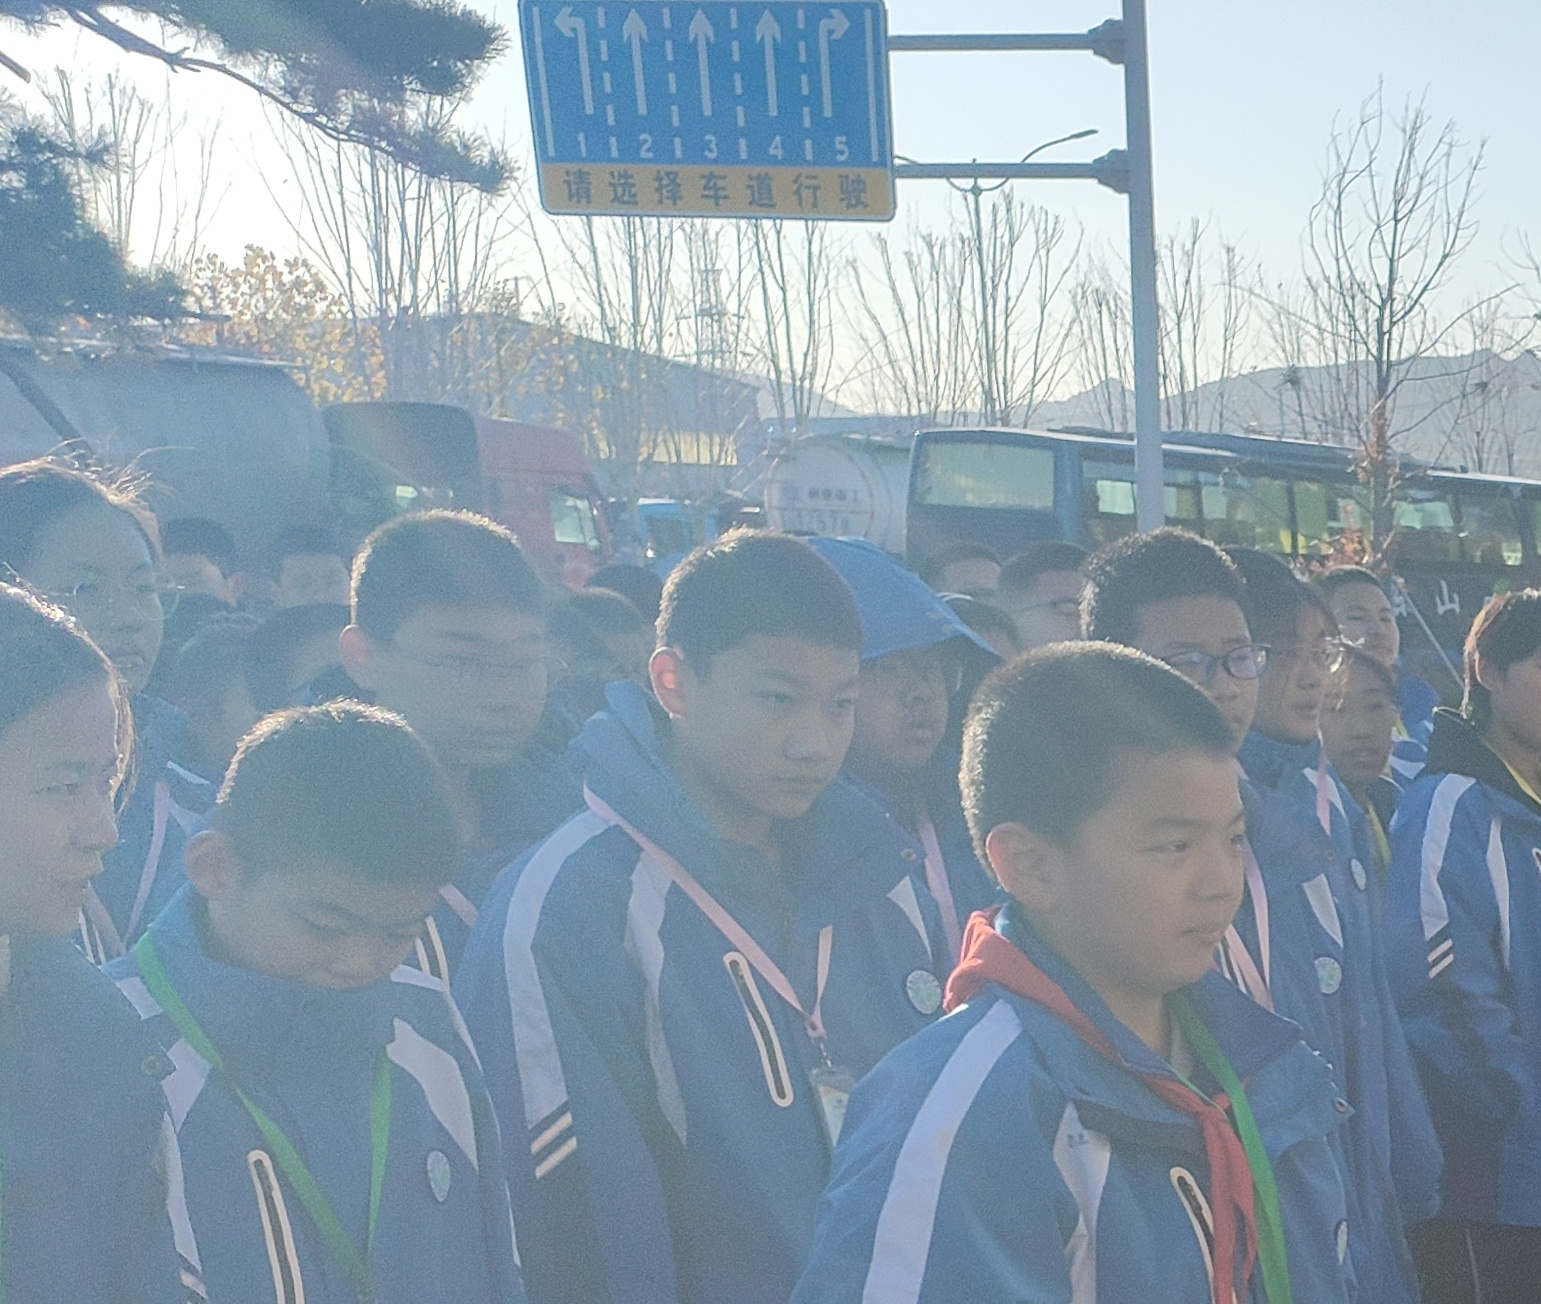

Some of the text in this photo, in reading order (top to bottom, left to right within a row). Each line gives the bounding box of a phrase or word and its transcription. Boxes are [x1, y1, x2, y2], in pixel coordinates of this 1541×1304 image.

[577, 133, 849, 159] 1 2 3 4 5
[563, 168, 869, 210] 请选择车道行驶
